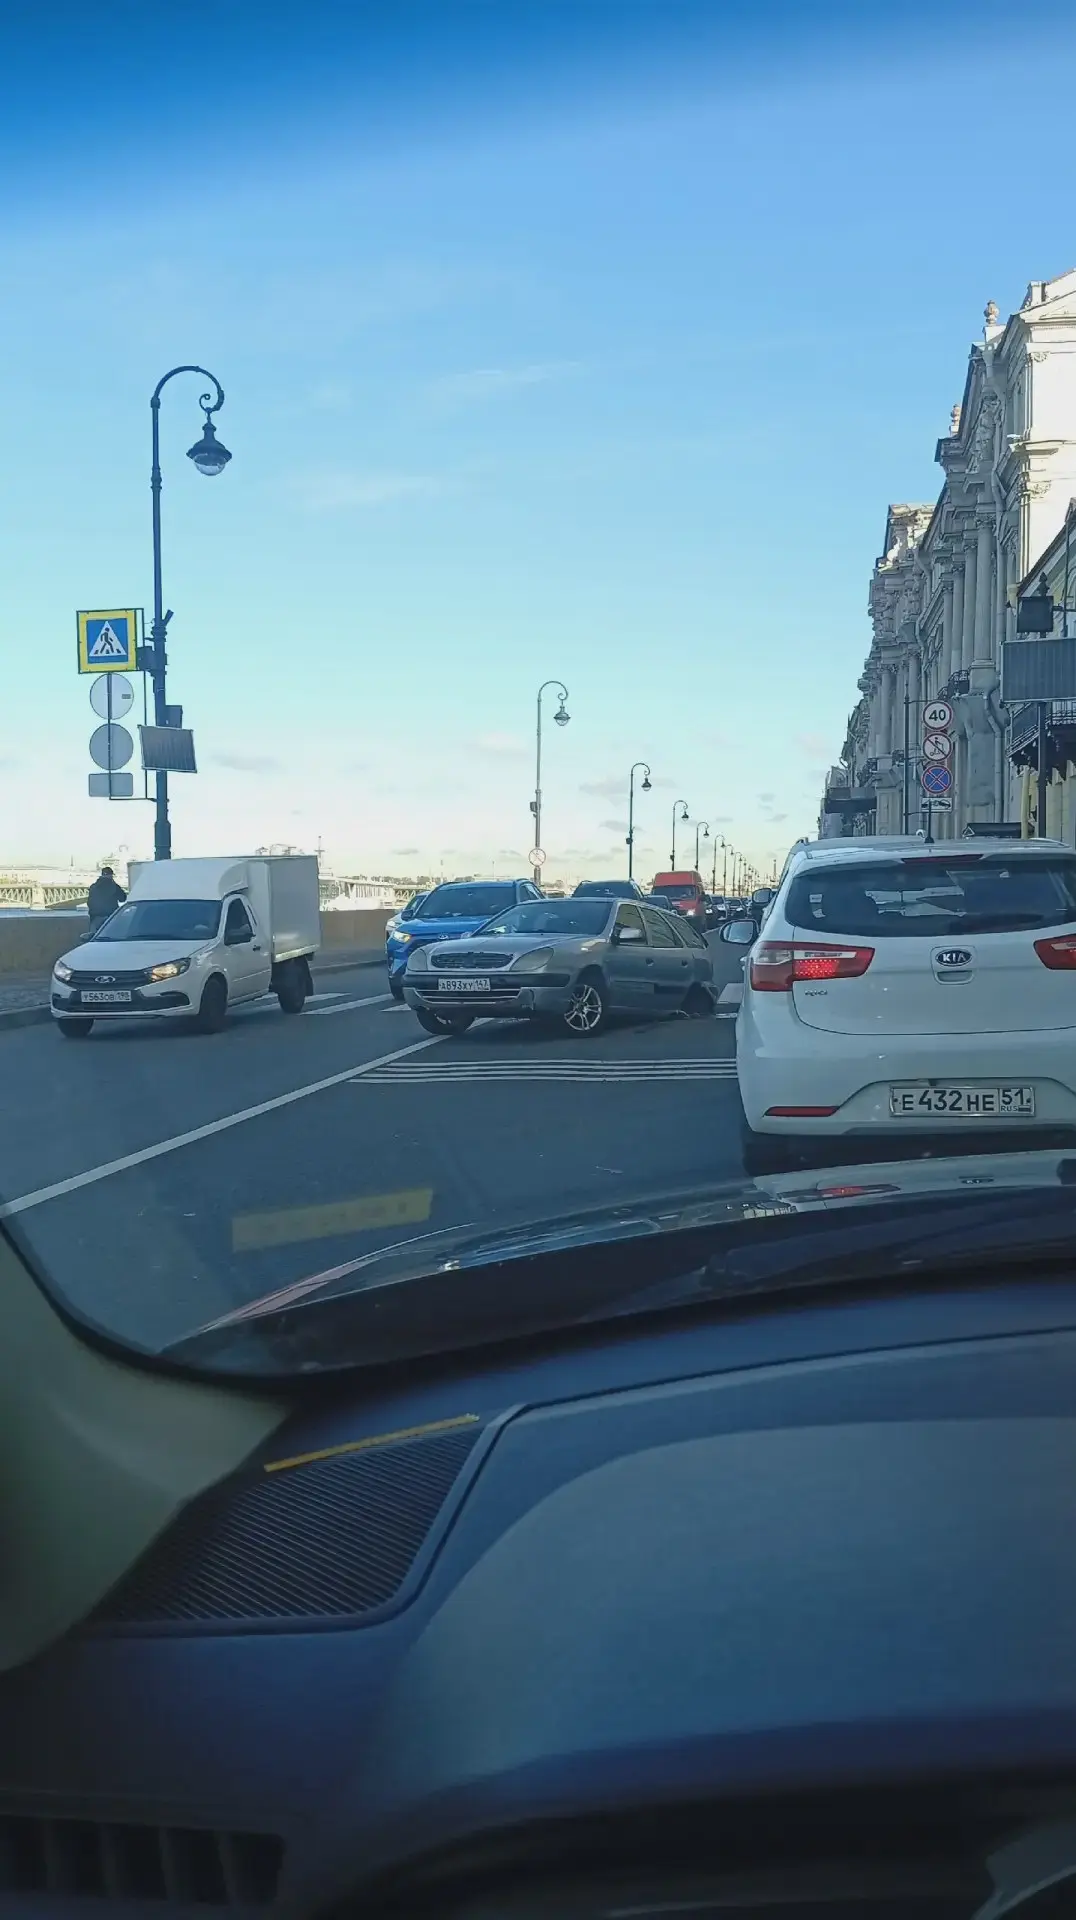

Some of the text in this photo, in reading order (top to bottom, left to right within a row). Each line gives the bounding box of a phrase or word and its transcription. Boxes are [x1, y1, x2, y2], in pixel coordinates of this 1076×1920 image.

[929, 709, 946, 721] 40
[942, 953, 967, 962] KIA
[1001, 1089, 1024, 1106] 51
